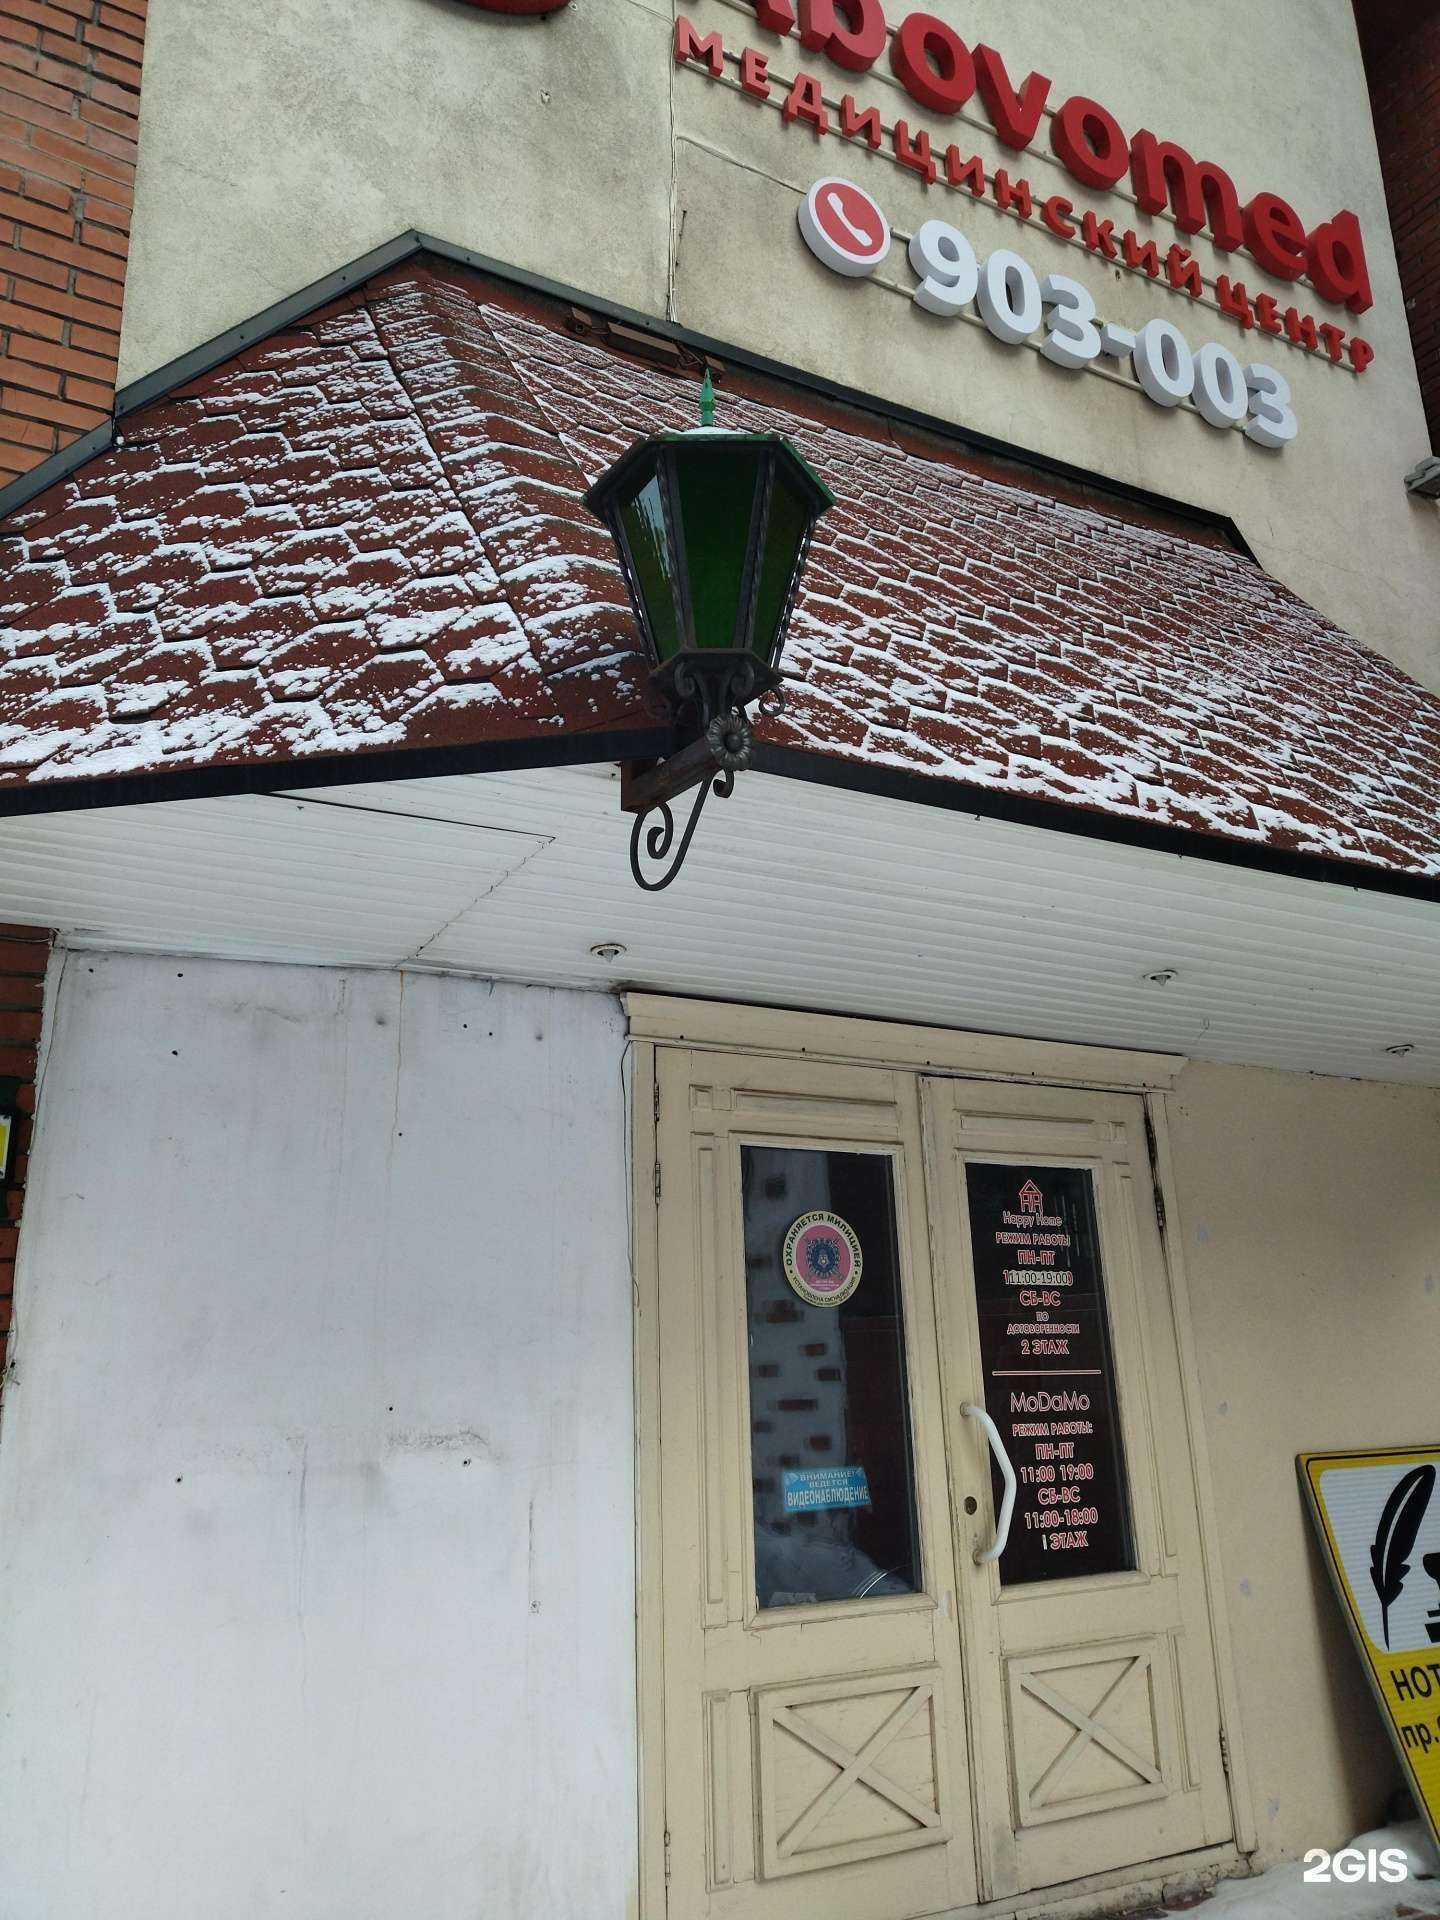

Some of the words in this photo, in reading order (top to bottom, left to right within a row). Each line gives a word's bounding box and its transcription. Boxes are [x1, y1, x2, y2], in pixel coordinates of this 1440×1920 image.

[674, 15, 1203, 298] МЕДИЦИНСКИЙ
[1216, 274, 1375, 373] ЦЕНТР
[908, 219, 1299, 449] 903-003
[1003, 1210, 1035, 1229] Happy
[785, 1213, 824, 1266] ОХРАНЯЕТСЯ
[996, 1232, 1032, 1245] РЕЖИМ
[1018, 1250, 1056, 1265] ПН-ПТ
[1020, 1291, 1061, 1306] СБ-ВС
[1021, 1339, 1031, 1355] 2
[1032, 1340, 1069, 1355] ЭТАЖ
[1010, 1391, 1090, 1412] MoDaMo
[1012, 1423, 1049, 1437] РЕЖИМ
[1035, 1443, 1074, 1460] ПН-ПТ
[787, 1486, 869, 1507] ВИДЕОНАБЛЮДЕНИЕ
[1038, 1486, 1080, 1505] СБ-ВС
[1024, 1507, 1099, 1529] 11:00-18:00
[1050, 1531, 1089, 1550] ЭТАЖ
